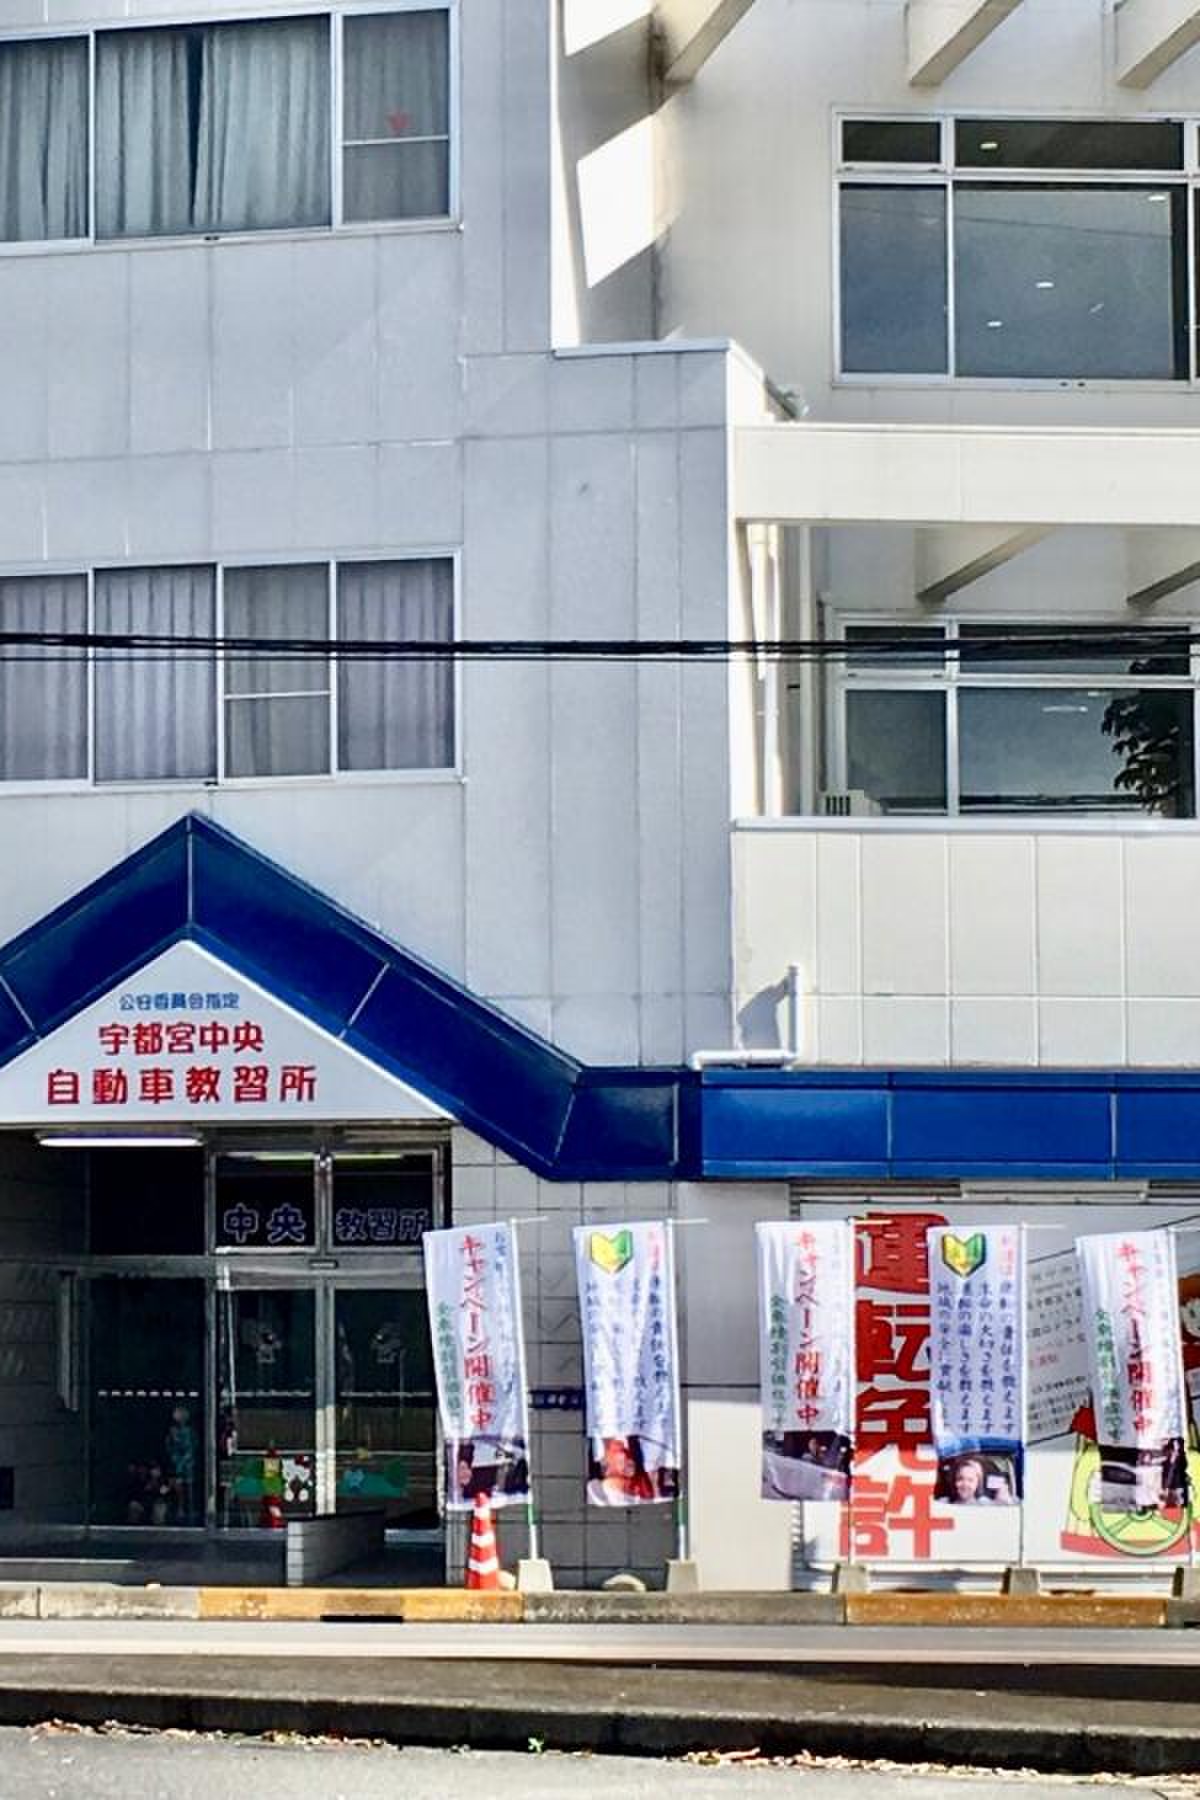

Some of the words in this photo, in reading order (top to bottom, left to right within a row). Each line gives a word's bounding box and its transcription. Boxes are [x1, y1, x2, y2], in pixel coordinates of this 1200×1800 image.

[99, 1021, 264, 1055] 宇都宮中央
[47, 1066, 316, 1104] 自動車教習所
[223, 1203, 306, 1244] 中央
[336, 1208, 429, 1242] 教習所
[460, 1233, 496, 1430] キャンペーン開催中
[794, 1230, 821, 1426] キャンペーン開催中
